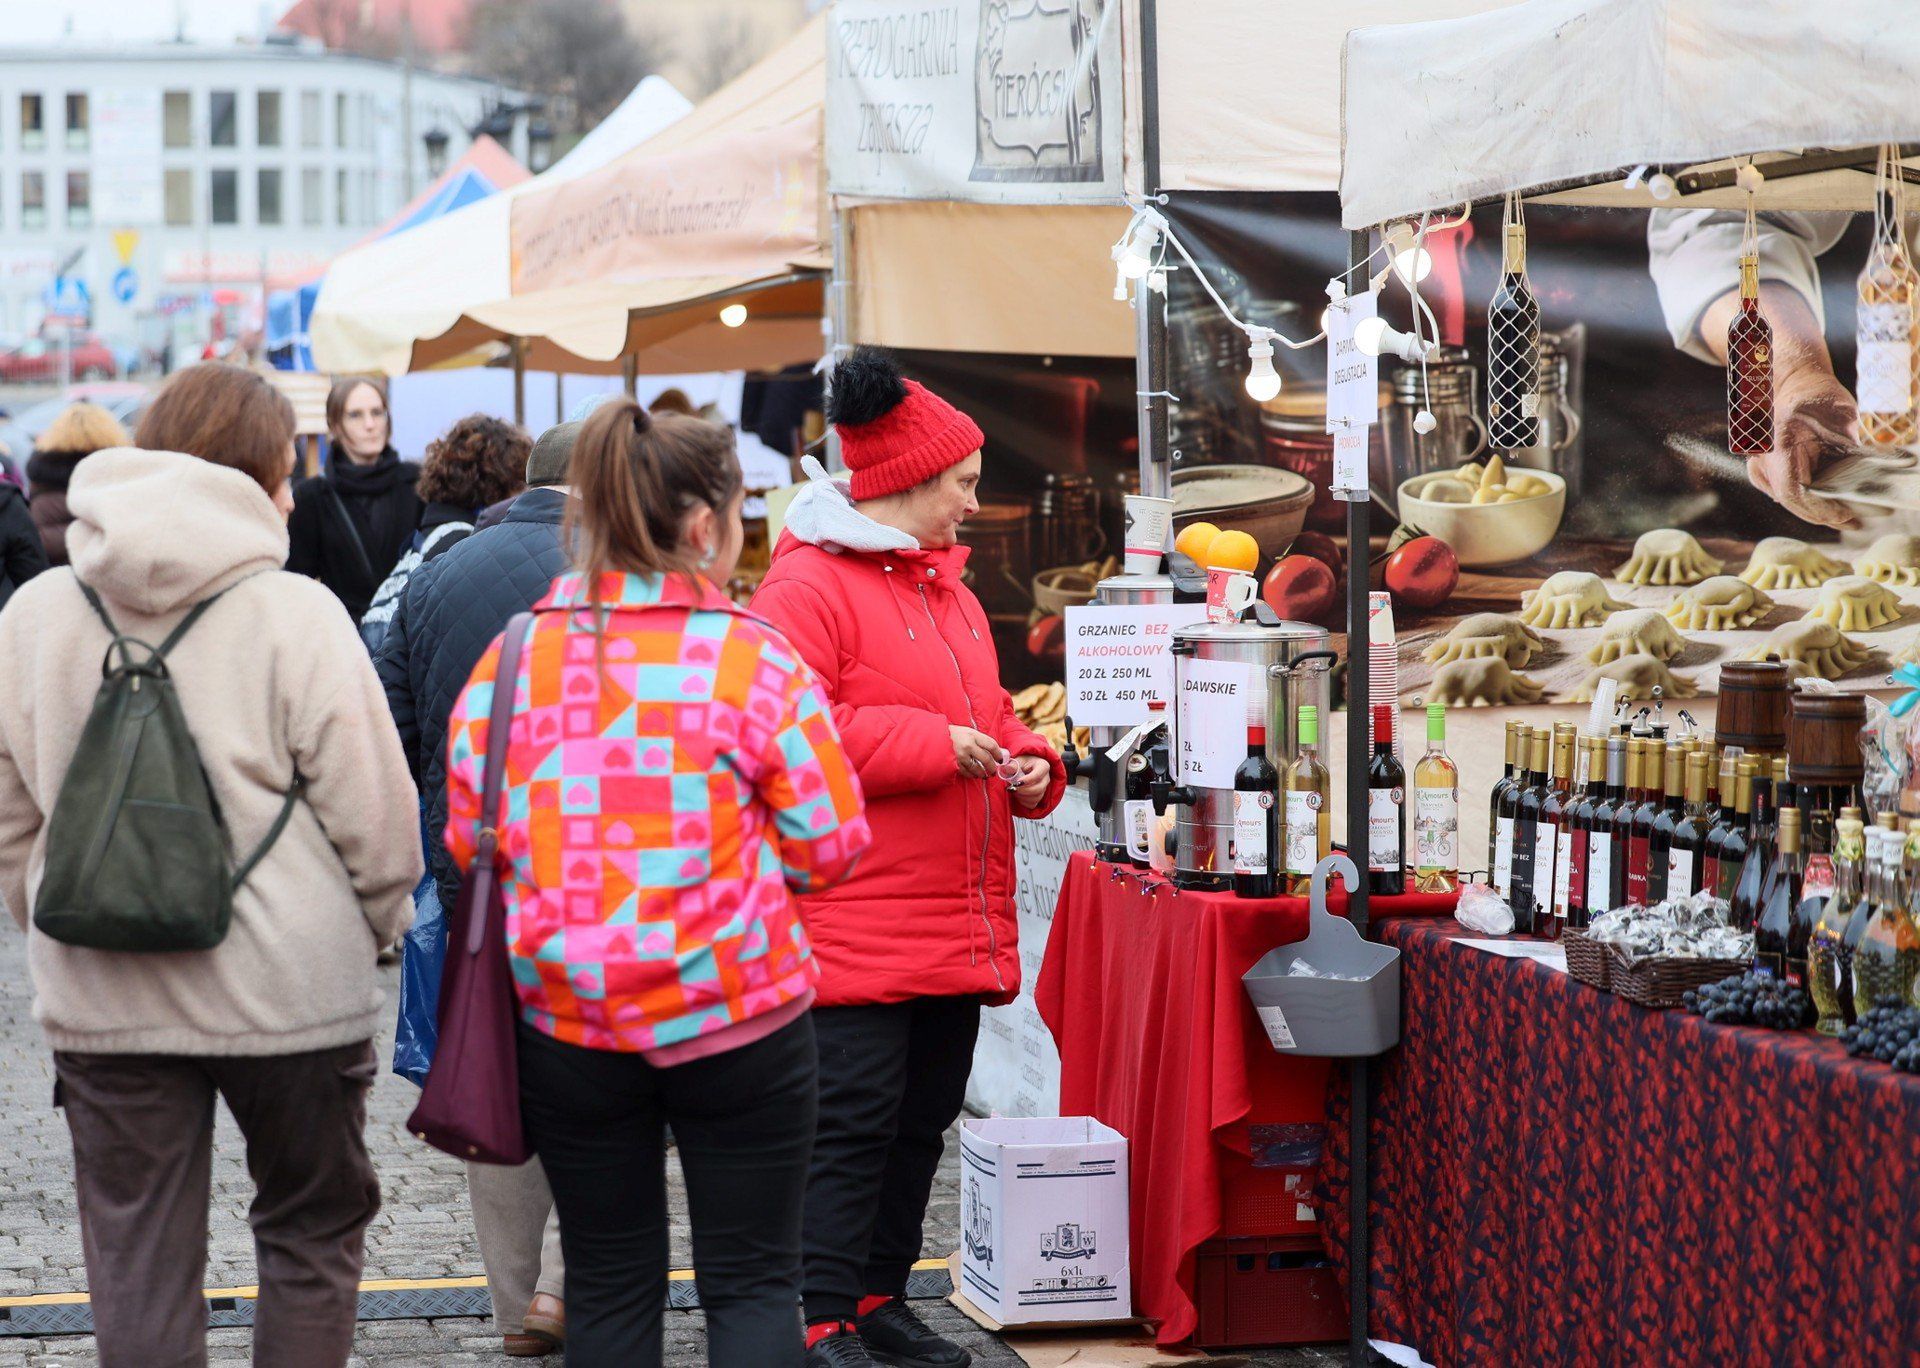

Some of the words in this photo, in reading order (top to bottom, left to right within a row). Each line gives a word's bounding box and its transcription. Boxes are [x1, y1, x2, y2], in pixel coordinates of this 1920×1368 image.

[1078, 624, 1137, 637] GRZANIEC
[1144, 623, 1169, 635] BEZ
[1077, 644, 1164, 657] ALKOHOLOWY
[1078, 668, 1092, 679] 20
[1093, 668, 1107, 679] ZŁ
[1112, 667, 1132, 679] 250
[1134, 667, 1152, 678] ML
[1183, 679, 1237, 695] DAWSKIE
[1079, 690, 1093, 701] 30
[1095, 690, 1108, 701] ZŁ
[1115, 690, 1136, 701] 450
[1140, 689, 1159, 700] ML
[1184, 741, 1193, 752] ZŁ
[1192, 761, 1203, 772] ZŁ
[1082, 1236, 1094, 1246] W
